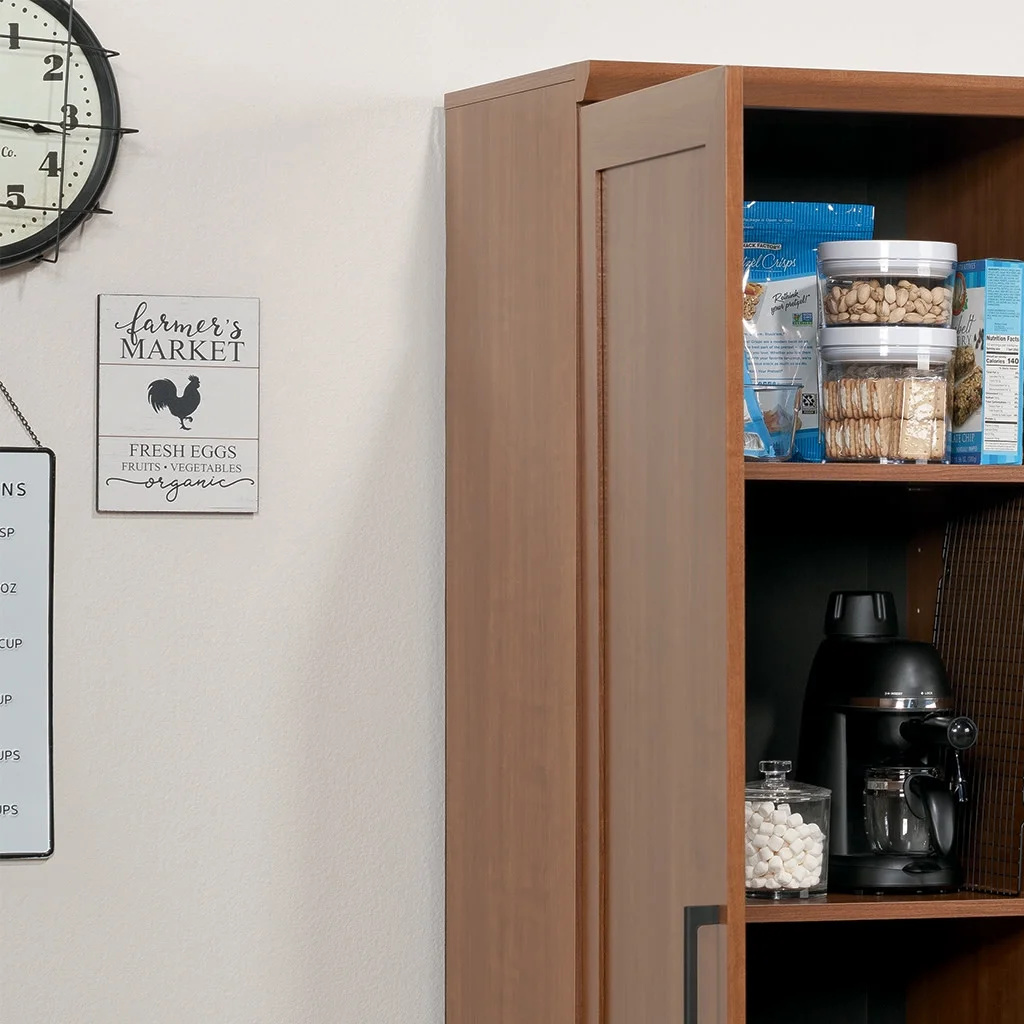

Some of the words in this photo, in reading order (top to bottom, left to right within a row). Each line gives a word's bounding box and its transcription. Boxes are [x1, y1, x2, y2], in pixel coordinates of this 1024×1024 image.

[9, 23, 20, 49] 1
[43, 55, 64, 81] 2
[60, 104, 78, 130] 3
[2, 146, 16, 158] Co.
[38, 152, 62, 177] 4
[6, 185, 26, 210] 5
[762, 253, 796, 272] Crisps
[114, 302, 242, 346] farmer's
[120, 338, 245, 362] MARKET
[130, 444, 184, 458] FRESH
[191, 445, 237, 459] EGGS
[122, 462, 161, 472] FRUITS
[170, 463, 242, 473] VEGETABLES
[106, 476, 254, 502] organic
[0, 583, 17, 594] OZ
[0, 805, 18, 815] PS
